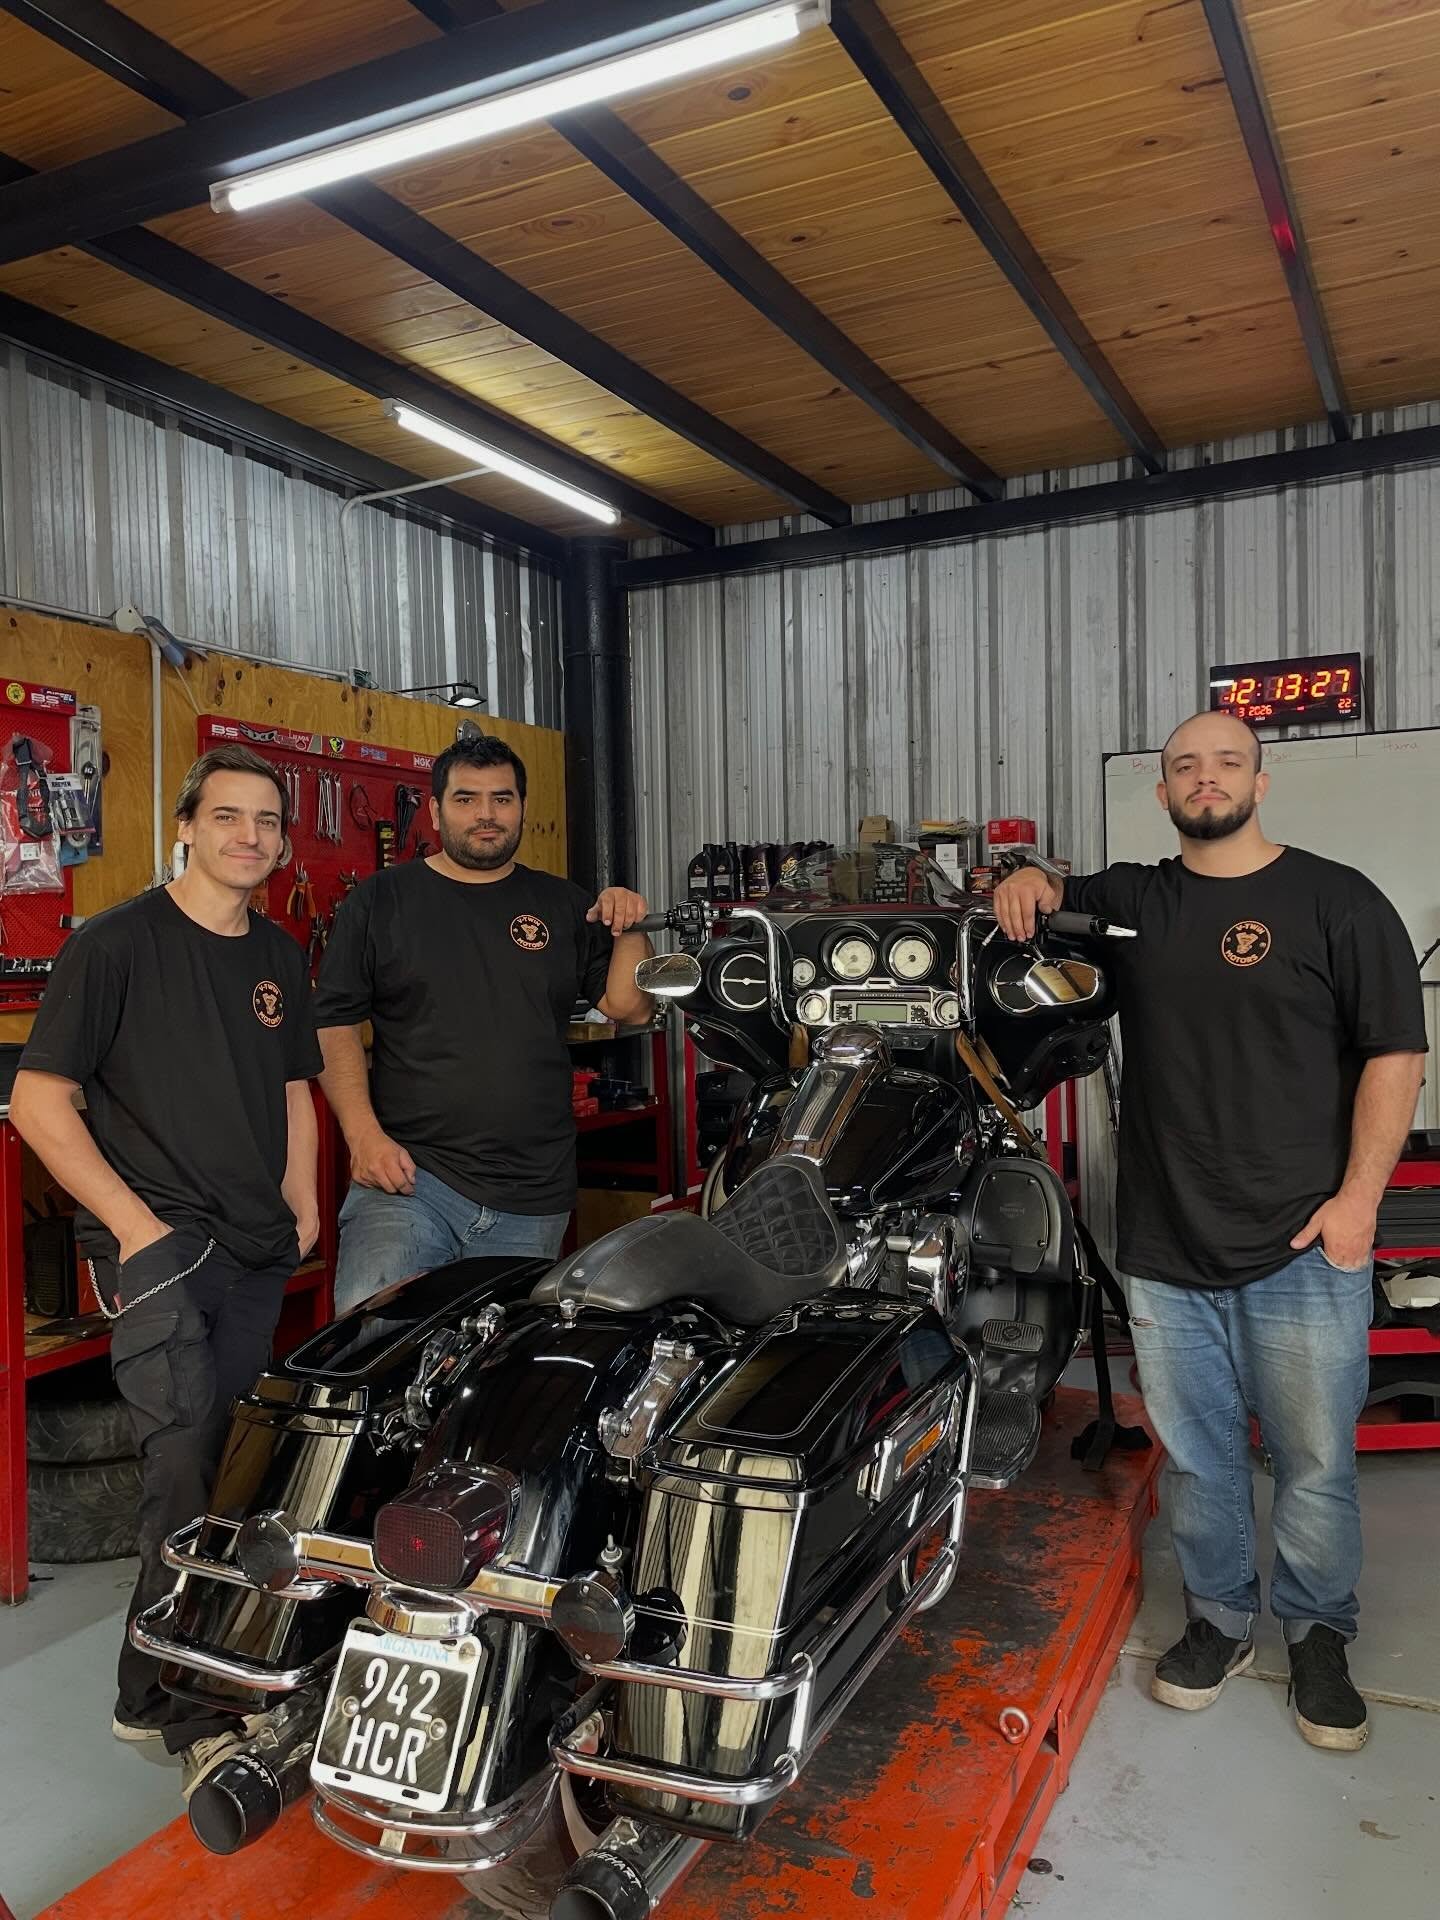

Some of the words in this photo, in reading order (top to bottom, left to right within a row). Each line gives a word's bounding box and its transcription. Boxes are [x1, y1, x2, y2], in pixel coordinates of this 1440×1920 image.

[31, 692, 60, 705] BS
[1338, 698, 1352, 709] 22
[1248, 704, 1273, 717] 2026
[211, 724, 239, 737] BS
[413, 756, 432, 769] NGK
[1225, 950, 1259, 963] MOTORS
[376, 1637, 450, 1664] ARGENTINA
[361, 1657, 442, 1723] 942
[341, 1714, 428, 1784] HCR
